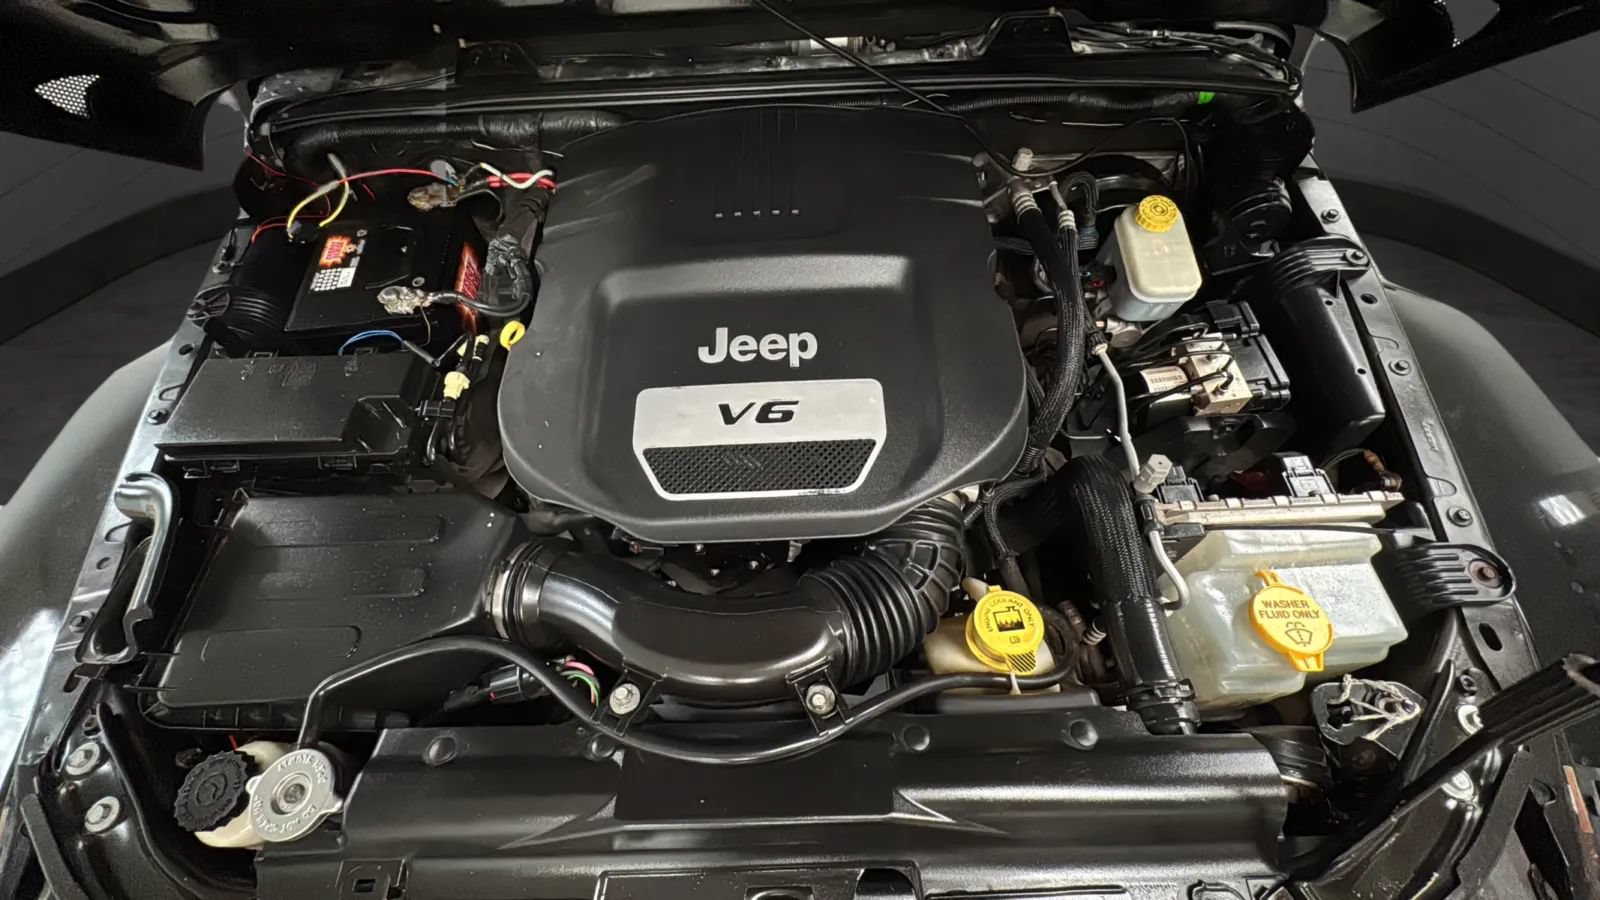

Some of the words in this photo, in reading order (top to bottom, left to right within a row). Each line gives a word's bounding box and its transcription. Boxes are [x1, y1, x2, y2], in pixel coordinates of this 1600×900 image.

[698, 327, 818, 367] Jeep
[718, 400, 799, 425] V6
[1259, 610, 1290, 619] FLUID
[1292, 609, 1320, 619] ONLY
[1261, 600, 1310, 609] WASHER
[1024, 608, 1035, 627] ONLY
